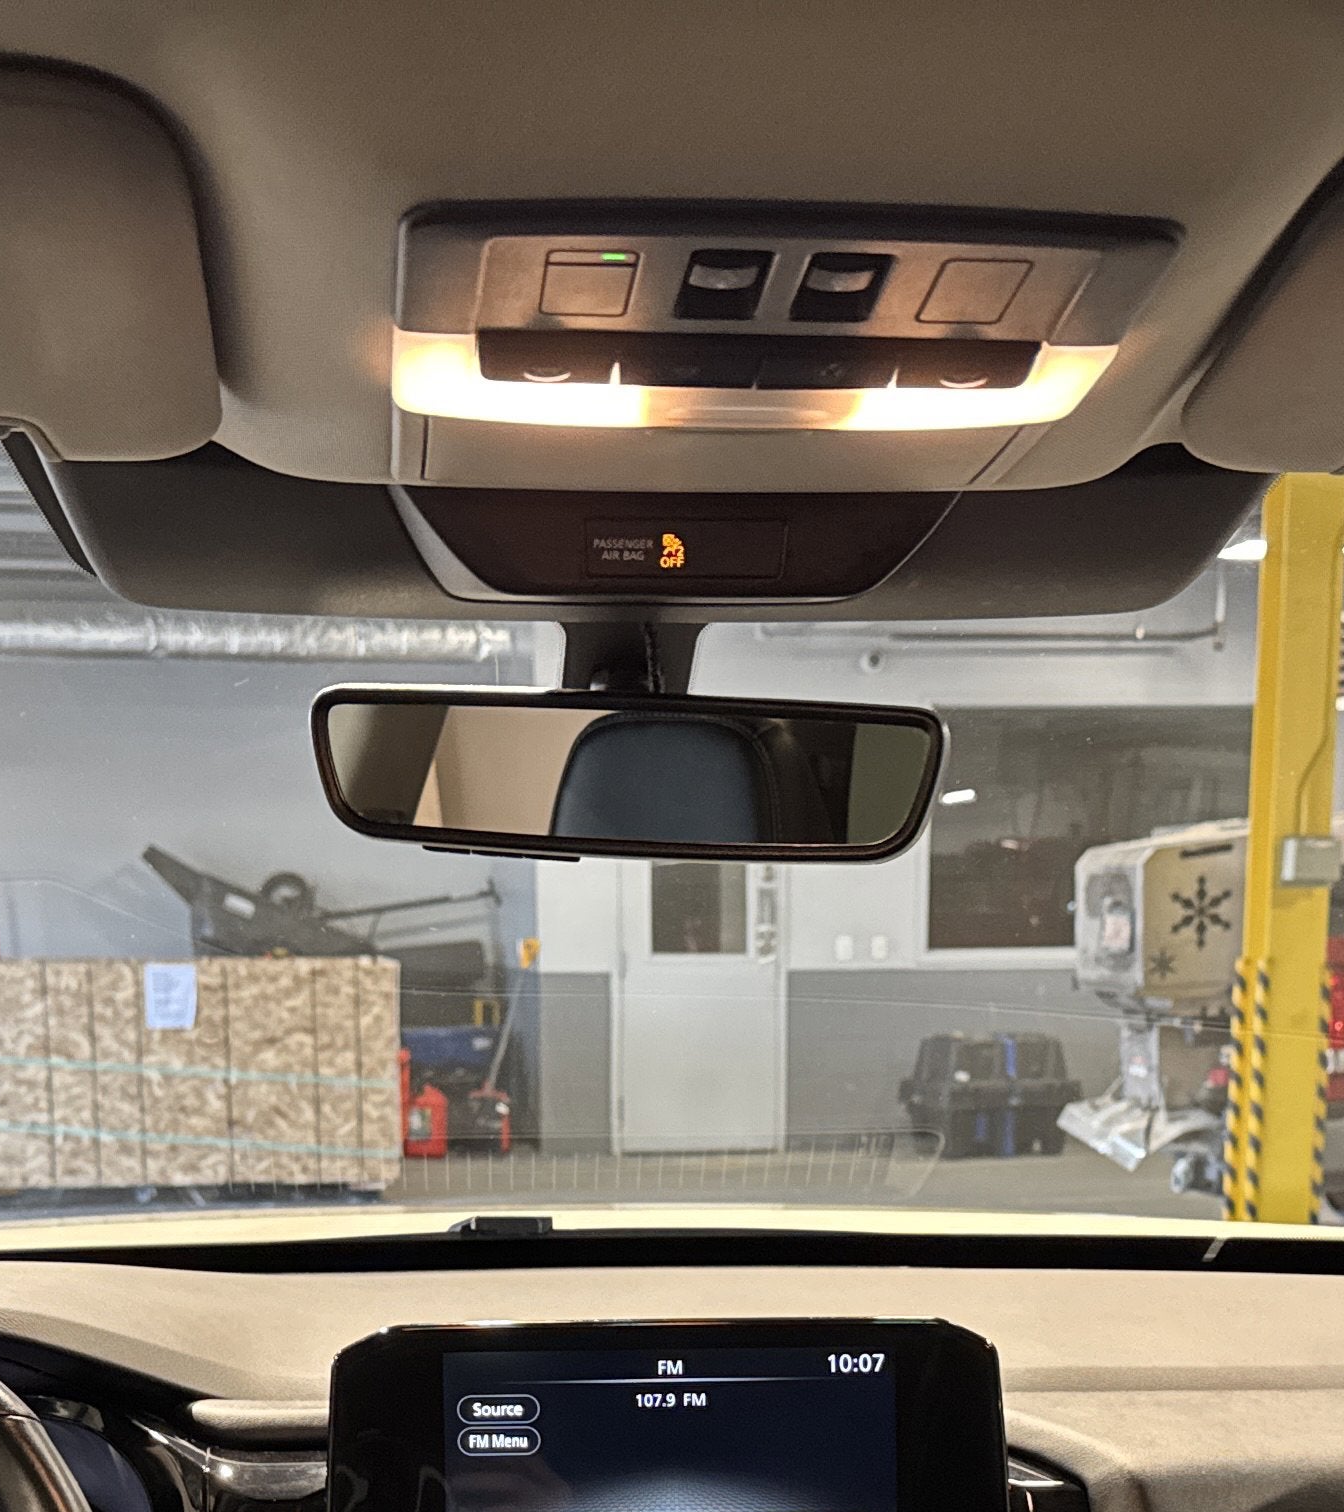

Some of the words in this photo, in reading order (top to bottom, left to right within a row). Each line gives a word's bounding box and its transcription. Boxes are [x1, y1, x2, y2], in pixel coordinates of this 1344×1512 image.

[593, 539, 653, 549] PASSENGER
[602, 551, 620, 560] AIR
[623, 551, 645, 560] BAG
[659, 557, 685, 568] OFF
[657, 1360, 683, 1376] FM
[827, 1353, 885, 1373] 10:07
[635, 1392, 677, 1407] 107.9
[683, 1392, 707, 1407] FM
[472, 1402, 525, 1417] Source
[469, 1434, 490, 1448] FM
[491, 1433, 529, 1448] Menu
